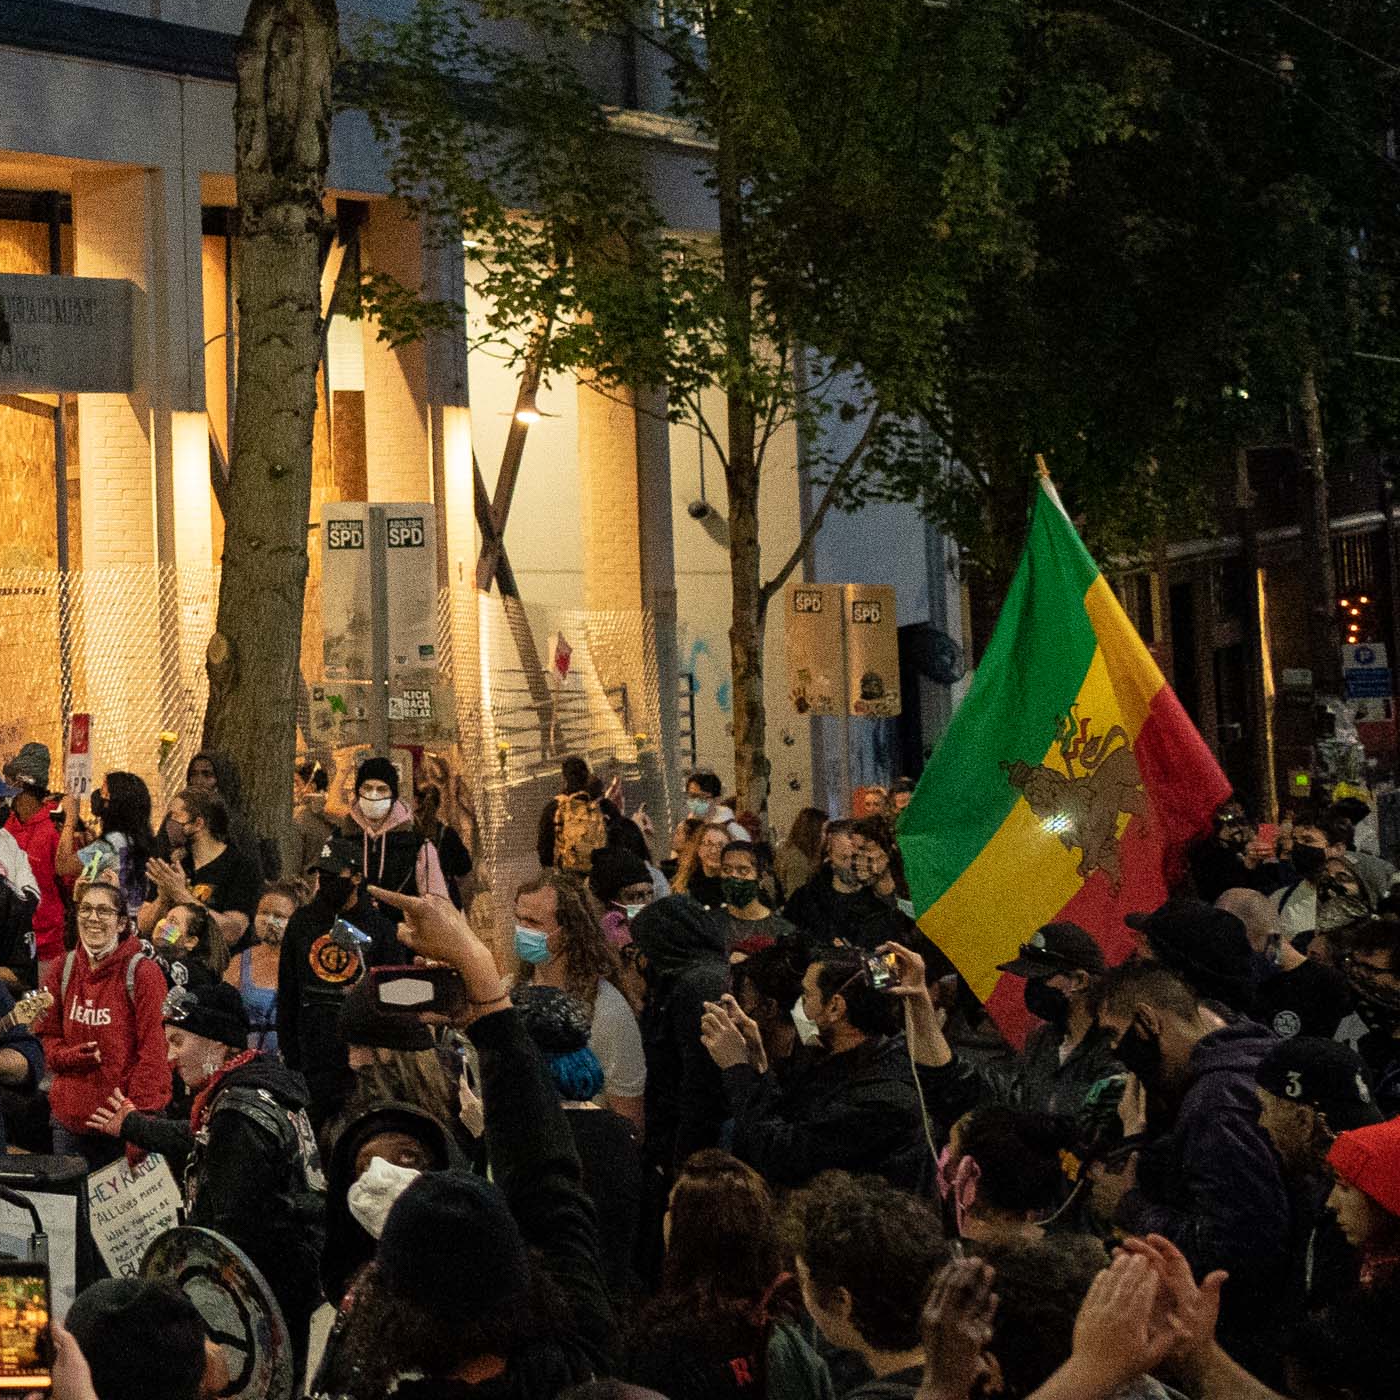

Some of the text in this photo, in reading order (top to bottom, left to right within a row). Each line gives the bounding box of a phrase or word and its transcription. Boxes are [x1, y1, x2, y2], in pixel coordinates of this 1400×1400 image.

[330, 530, 362, 547] SPD
[389, 528, 423, 545] SPD
[795, 598, 821, 612] SPD
[853, 608, 880, 623] SPD
[1285, 1070, 1302, 1098] 3
[89, 1176, 120, 1208] HEY
[116, 1197, 139, 1218] LIVES
